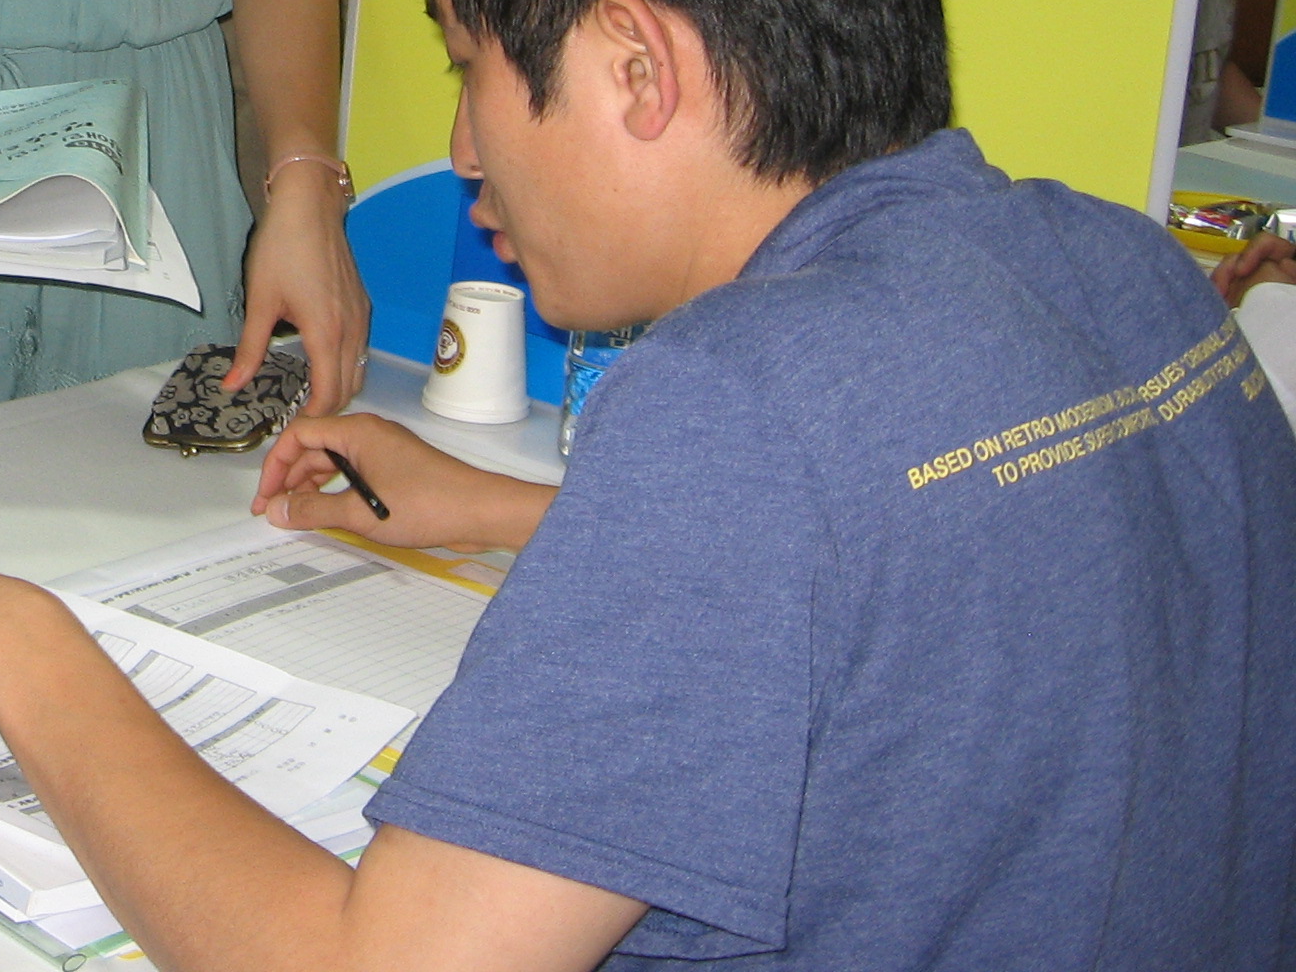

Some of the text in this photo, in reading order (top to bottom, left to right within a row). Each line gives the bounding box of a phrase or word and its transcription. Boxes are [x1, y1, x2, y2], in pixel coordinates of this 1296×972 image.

[906, 447, 973, 490] BASED
[973, 436, 1004, 463] ON
[1002, 416, 1056, 453] RETRO
[990, 462, 1019, 488] TO
[1019, 434, 1087, 478] PROVIDE
